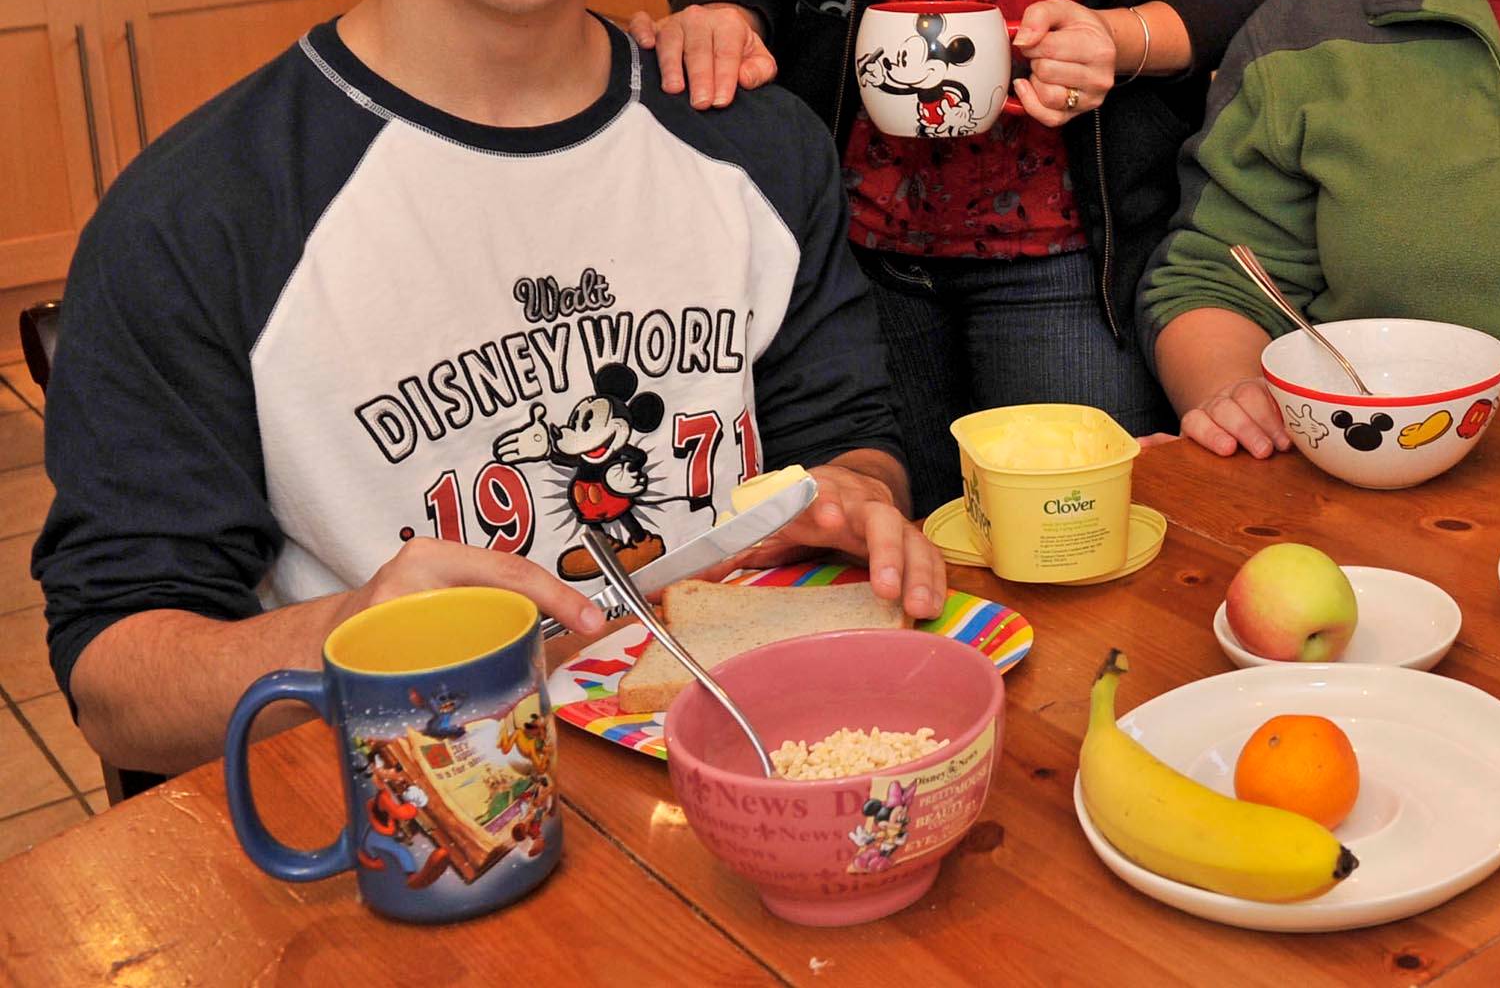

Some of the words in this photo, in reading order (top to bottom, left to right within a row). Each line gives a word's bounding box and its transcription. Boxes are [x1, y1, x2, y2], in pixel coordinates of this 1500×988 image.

[512, 267, 617, 323] Walt
[355, 321, 571, 465] DISNEY
[578, 308, 754, 384] WORL
[424, 460, 537, 558] 19
[1043, 498, 1096, 515] Clover
[715, 780, 808, 820] News
[779, 826, 843, 843] News
